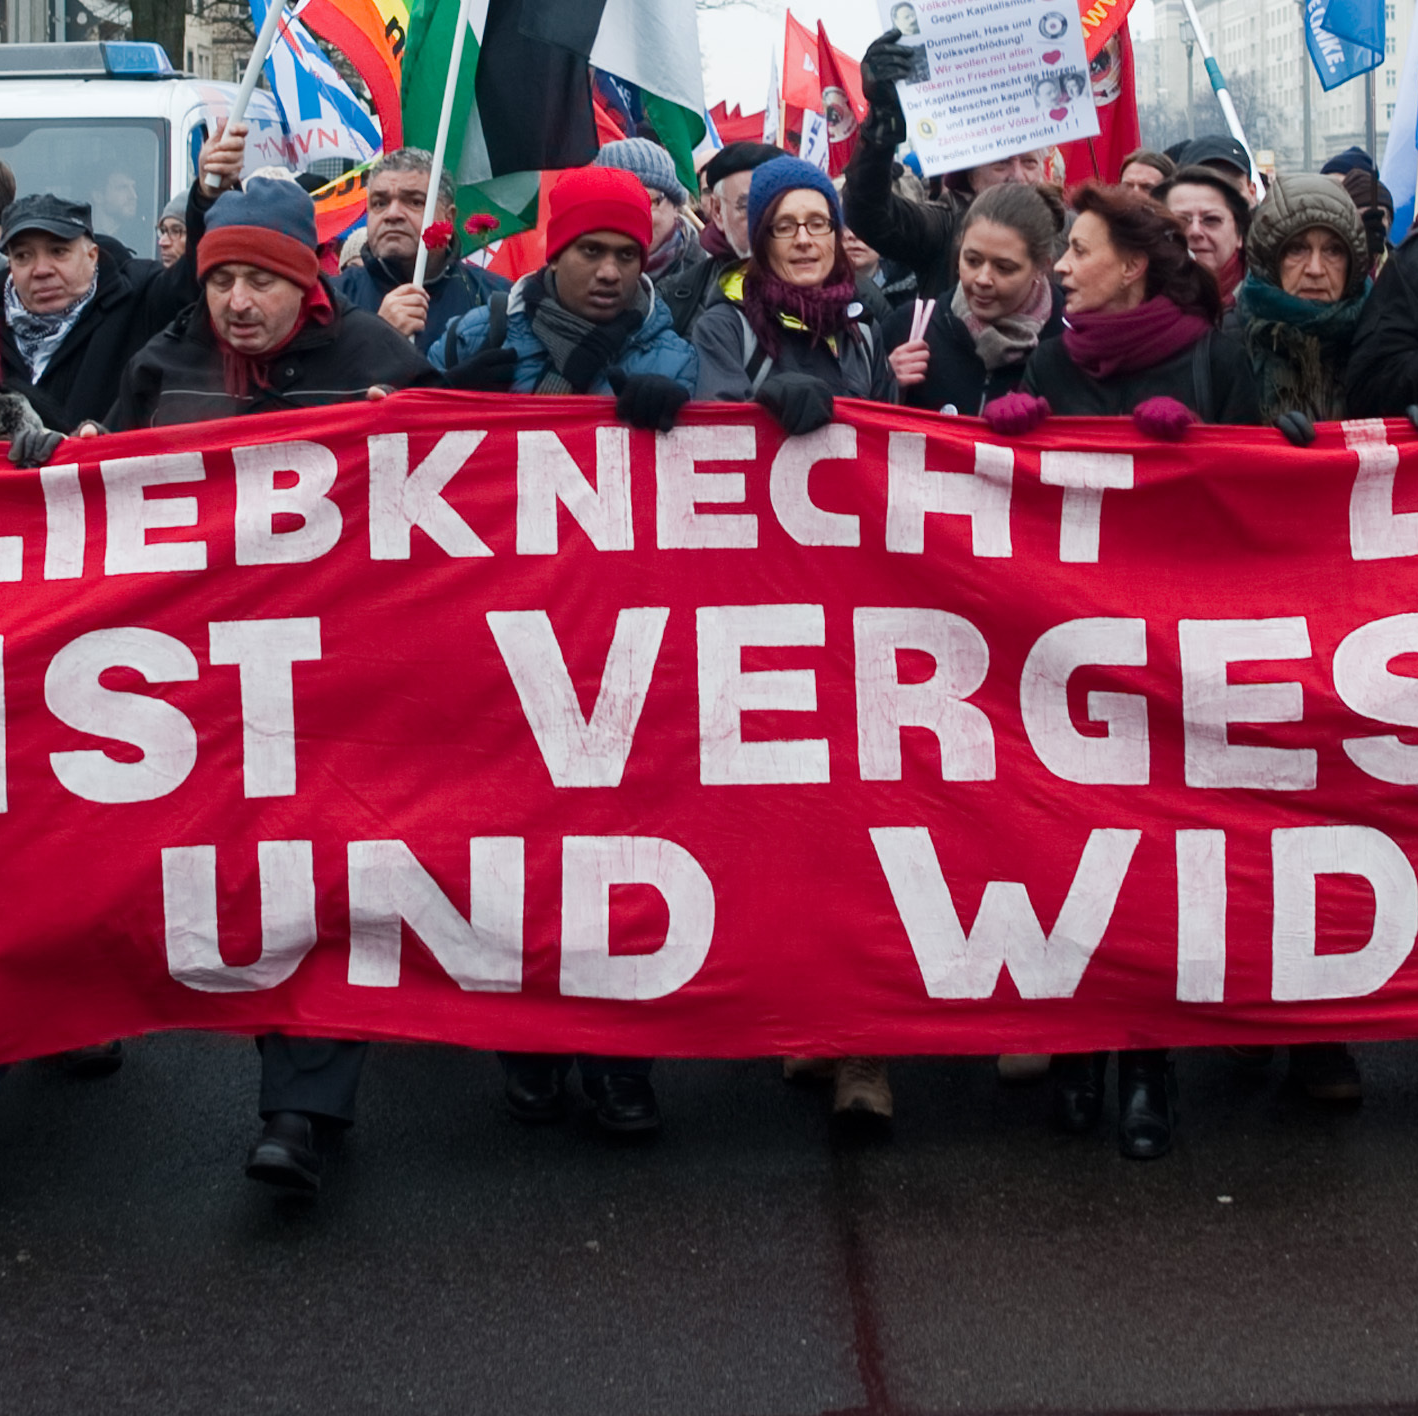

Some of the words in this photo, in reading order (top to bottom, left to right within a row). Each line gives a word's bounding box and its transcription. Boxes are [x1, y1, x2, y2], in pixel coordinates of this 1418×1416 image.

[931, 11, 965, 26] Gegen
[984, 24, 1009, 37] Hass
[1012, 17, 1031, 30] und
[934, 62, 952, 76] Wir
[955, 56, 988, 71] wollen
[991, 50, 1007, 63] mit
[1009, 46, 1034, 59] allen
[907, 98, 923, 111] Der
[924, 84, 989, 106] Kapitalismus
[991, 76, 1022, 91] macht
[1024, 71, 1040, 84] die
[1042, 63, 1077, 79] Herzen
[915, 79, 953, 96] Völkern
[955, 75, 966, 86] in
[967, 67, 1006, 82] Frieden
[1008, 60, 1036, 73] leben
[931, 108, 947, 120] der
[949, 96, 1000, 115] Menschen
[1001, 87, 1033, 103] kaputt
[947, 117, 965, 131] und
[966, 108, 1004, 125] zerstört
[1006, 104, 1022, 116] die
[924, 154, 941, 166] Wir
[943, 148, 972, 162] wollen
[973, 140, 995, 153] Eure
[996, 133, 1028, 148] Kriege
[1030, 126, 1055, 141] nicht
[937, 128, 989, 147] Zärtlichkeit
[991, 123, 1007, 135] der
[1009, 115, 1040, 130] Völker
[161, 835, 716, 1001] UND
